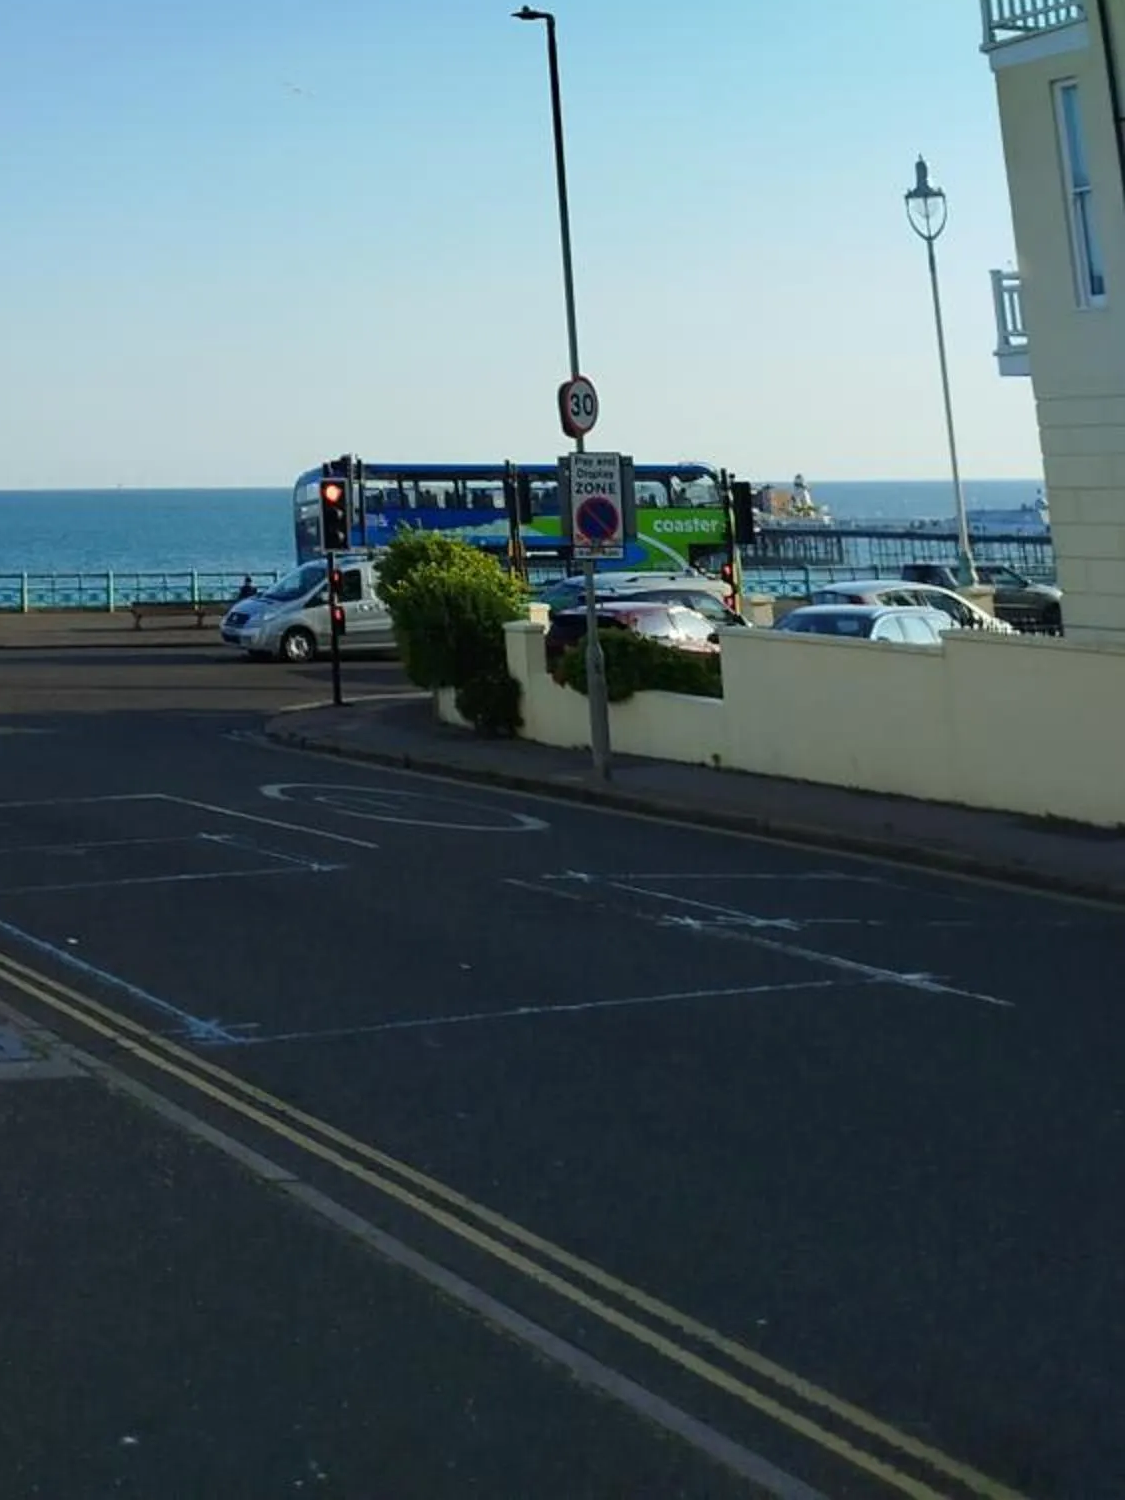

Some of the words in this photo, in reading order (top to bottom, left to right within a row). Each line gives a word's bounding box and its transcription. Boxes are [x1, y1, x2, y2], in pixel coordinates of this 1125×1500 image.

[570, 393, 594, 416] 30
[574, 481, 617, 494] ZONE
[652, 517, 719, 533] coaster
